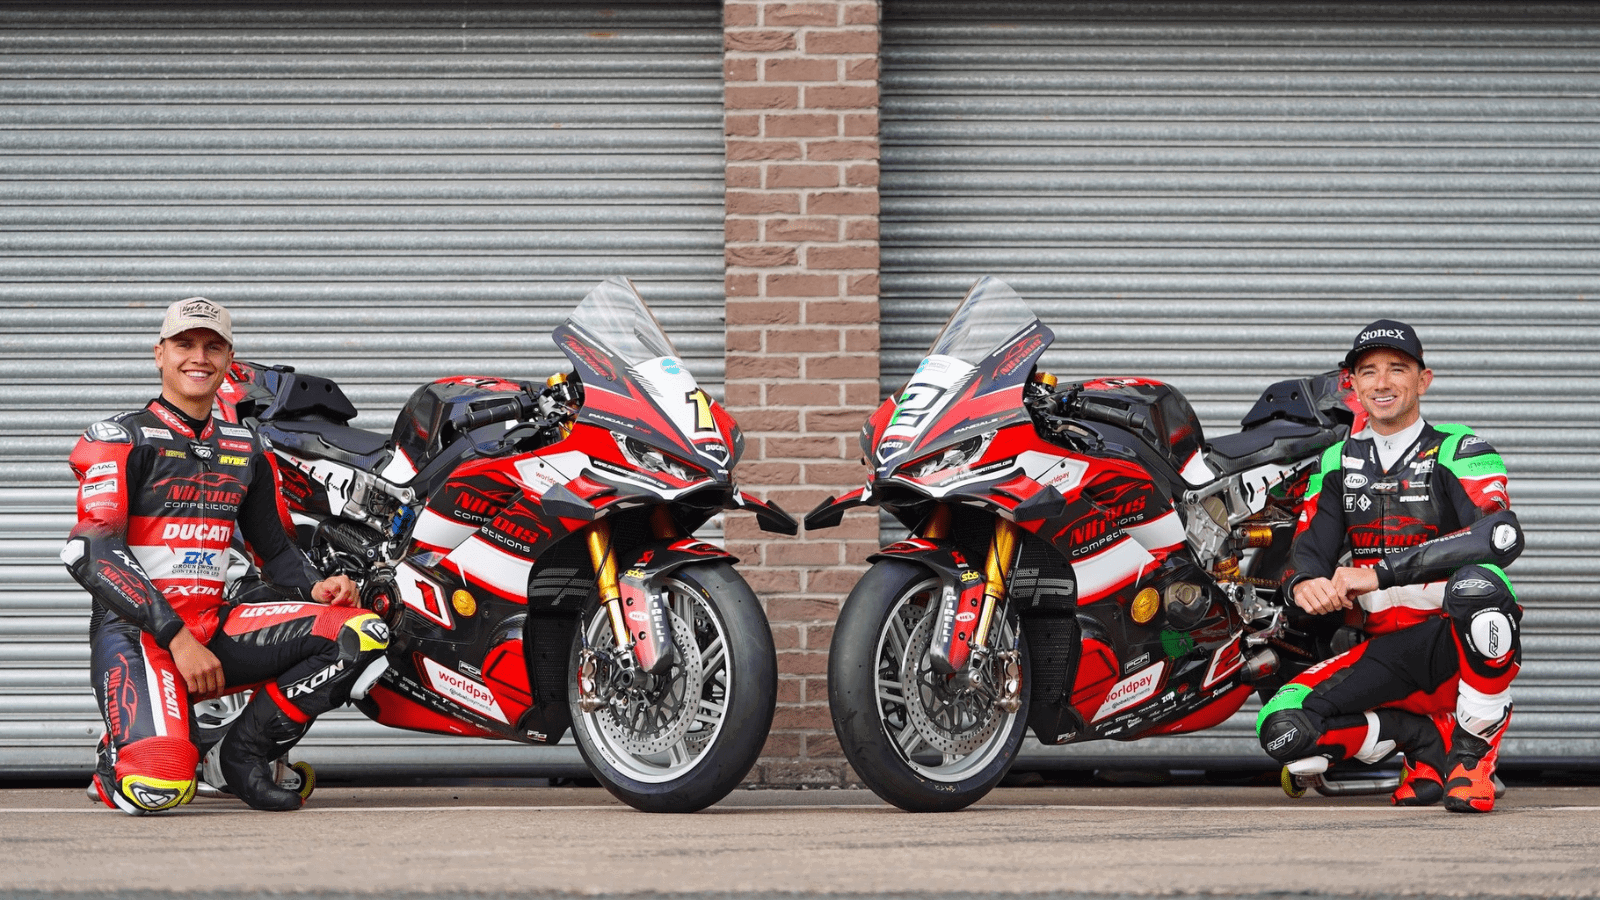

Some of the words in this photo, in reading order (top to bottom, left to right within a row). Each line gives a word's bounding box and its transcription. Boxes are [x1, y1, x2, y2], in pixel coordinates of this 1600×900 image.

[1359, 328, 1405, 343] StoneX
[685, 387, 717, 433] 1
[166, 485, 242, 505] Nitrous
[164, 501, 238, 512] competitions
[162, 523, 230, 542] DUCATI
[1354, 547, 1411, 555] competiti
[172, 563, 221, 571] GROUNWORKS
[414, 578, 443, 619] 1
[161, 668, 181, 720] DUCATI
[438, 671, 495, 706] worldpay
